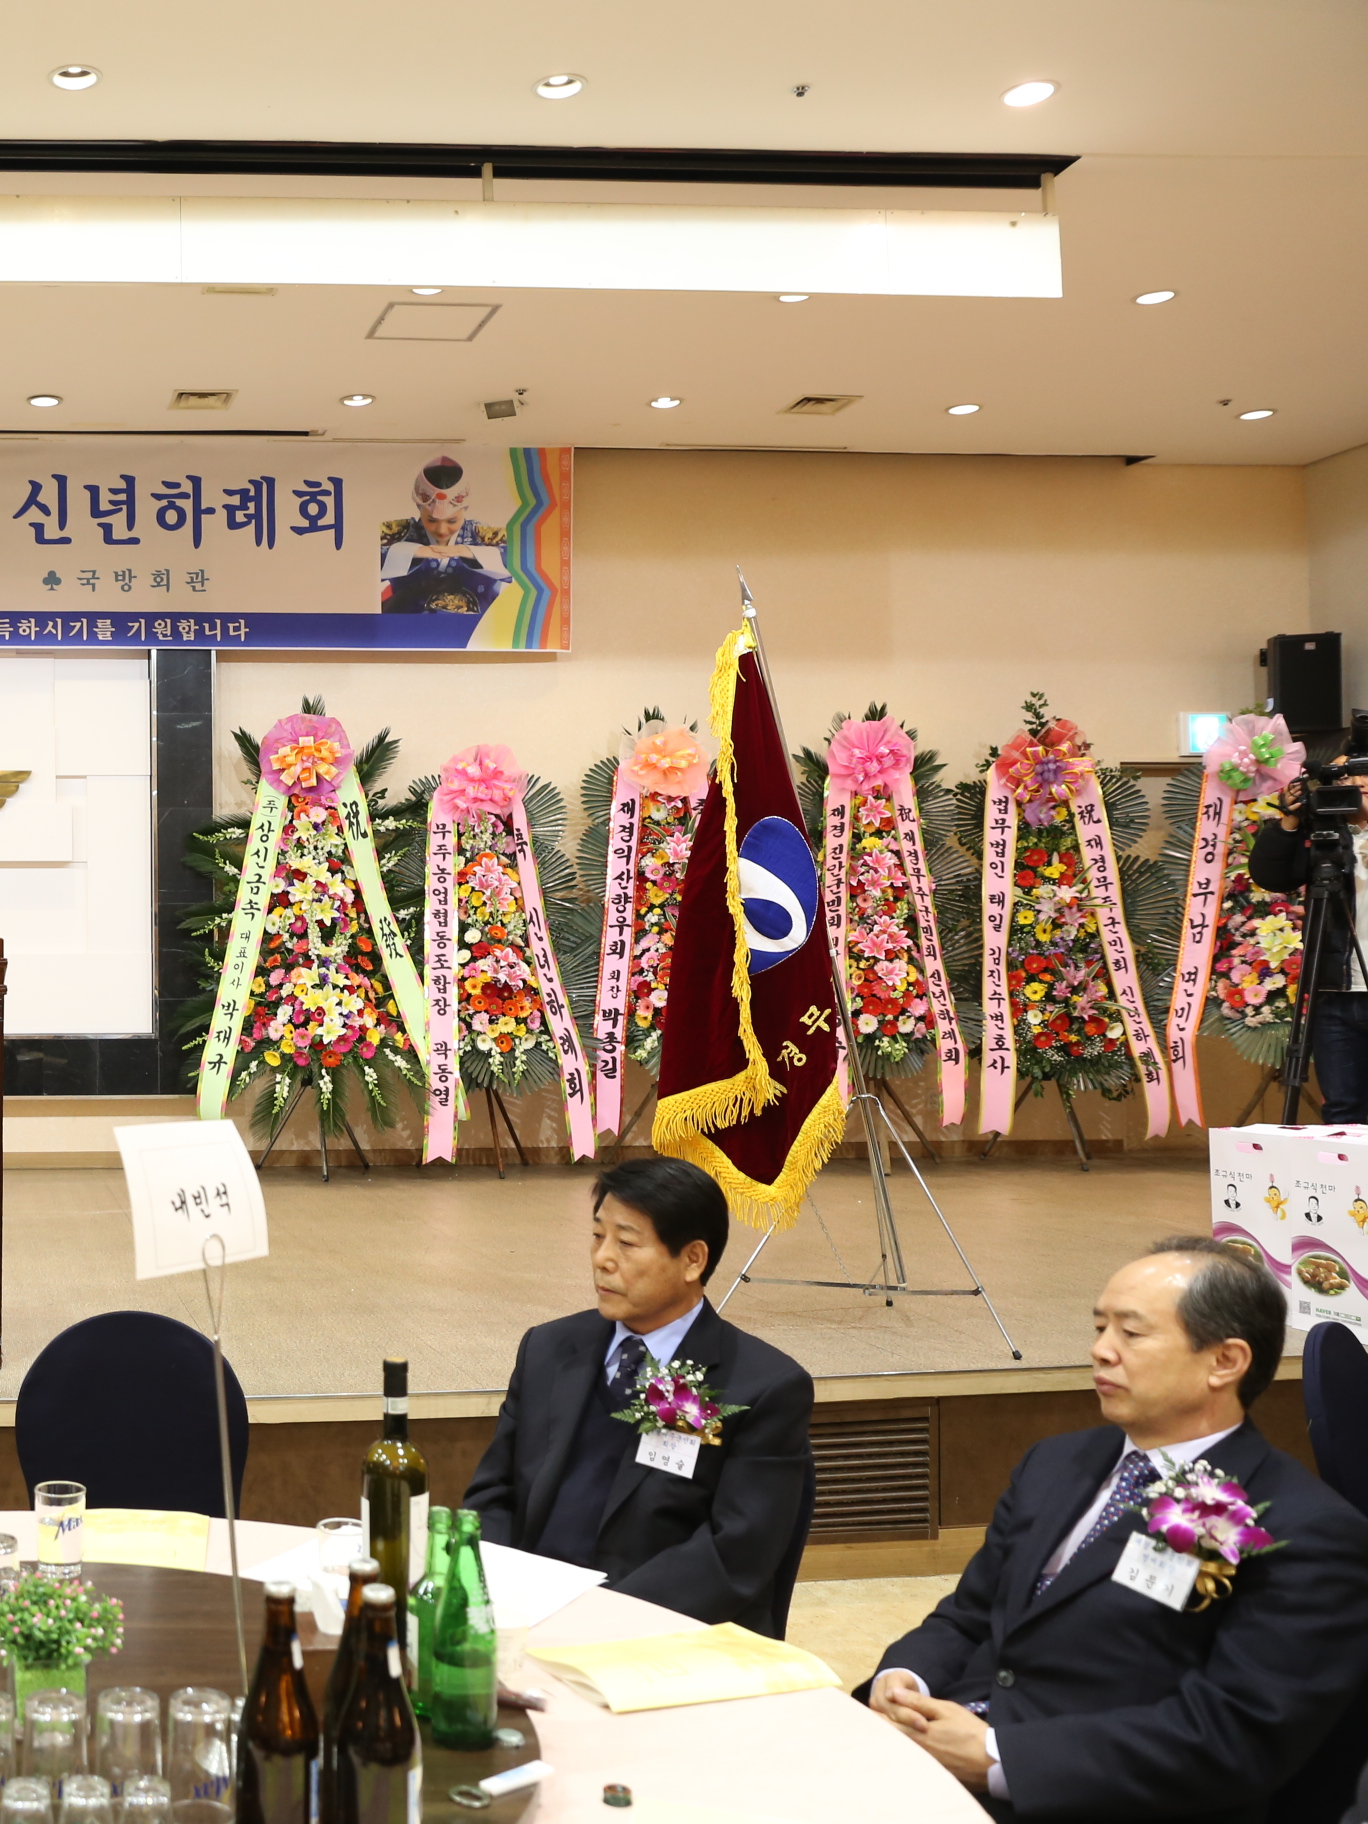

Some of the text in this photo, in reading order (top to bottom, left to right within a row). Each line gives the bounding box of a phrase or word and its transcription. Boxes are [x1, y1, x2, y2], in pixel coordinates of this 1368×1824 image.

[12, 472, 345, 552] 신년하례회
[76, 566, 212, 594] 국방회관
[126, 616, 250, 643] 기원합니다
[341, 800, 369, 842] 祝
[989, 795, 1012, 879] 법무법인
[1077, 803, 1103, 826] 祝
[1199, 796, 1224, 864] 재경
[896, 804, 916, 823] 祝
[929, 969, 961, 1066] 신년하례회
[988, 891, 1006, 933] 태일
[229, 930, 252, 990] 대표이사
[607, 969, 622, 999] 회장
[206, 999, 240, 1076] 박재규
[598, 1007, 624, 1080] 박종길
[170, 1181, 231, 1223] 내빈석
